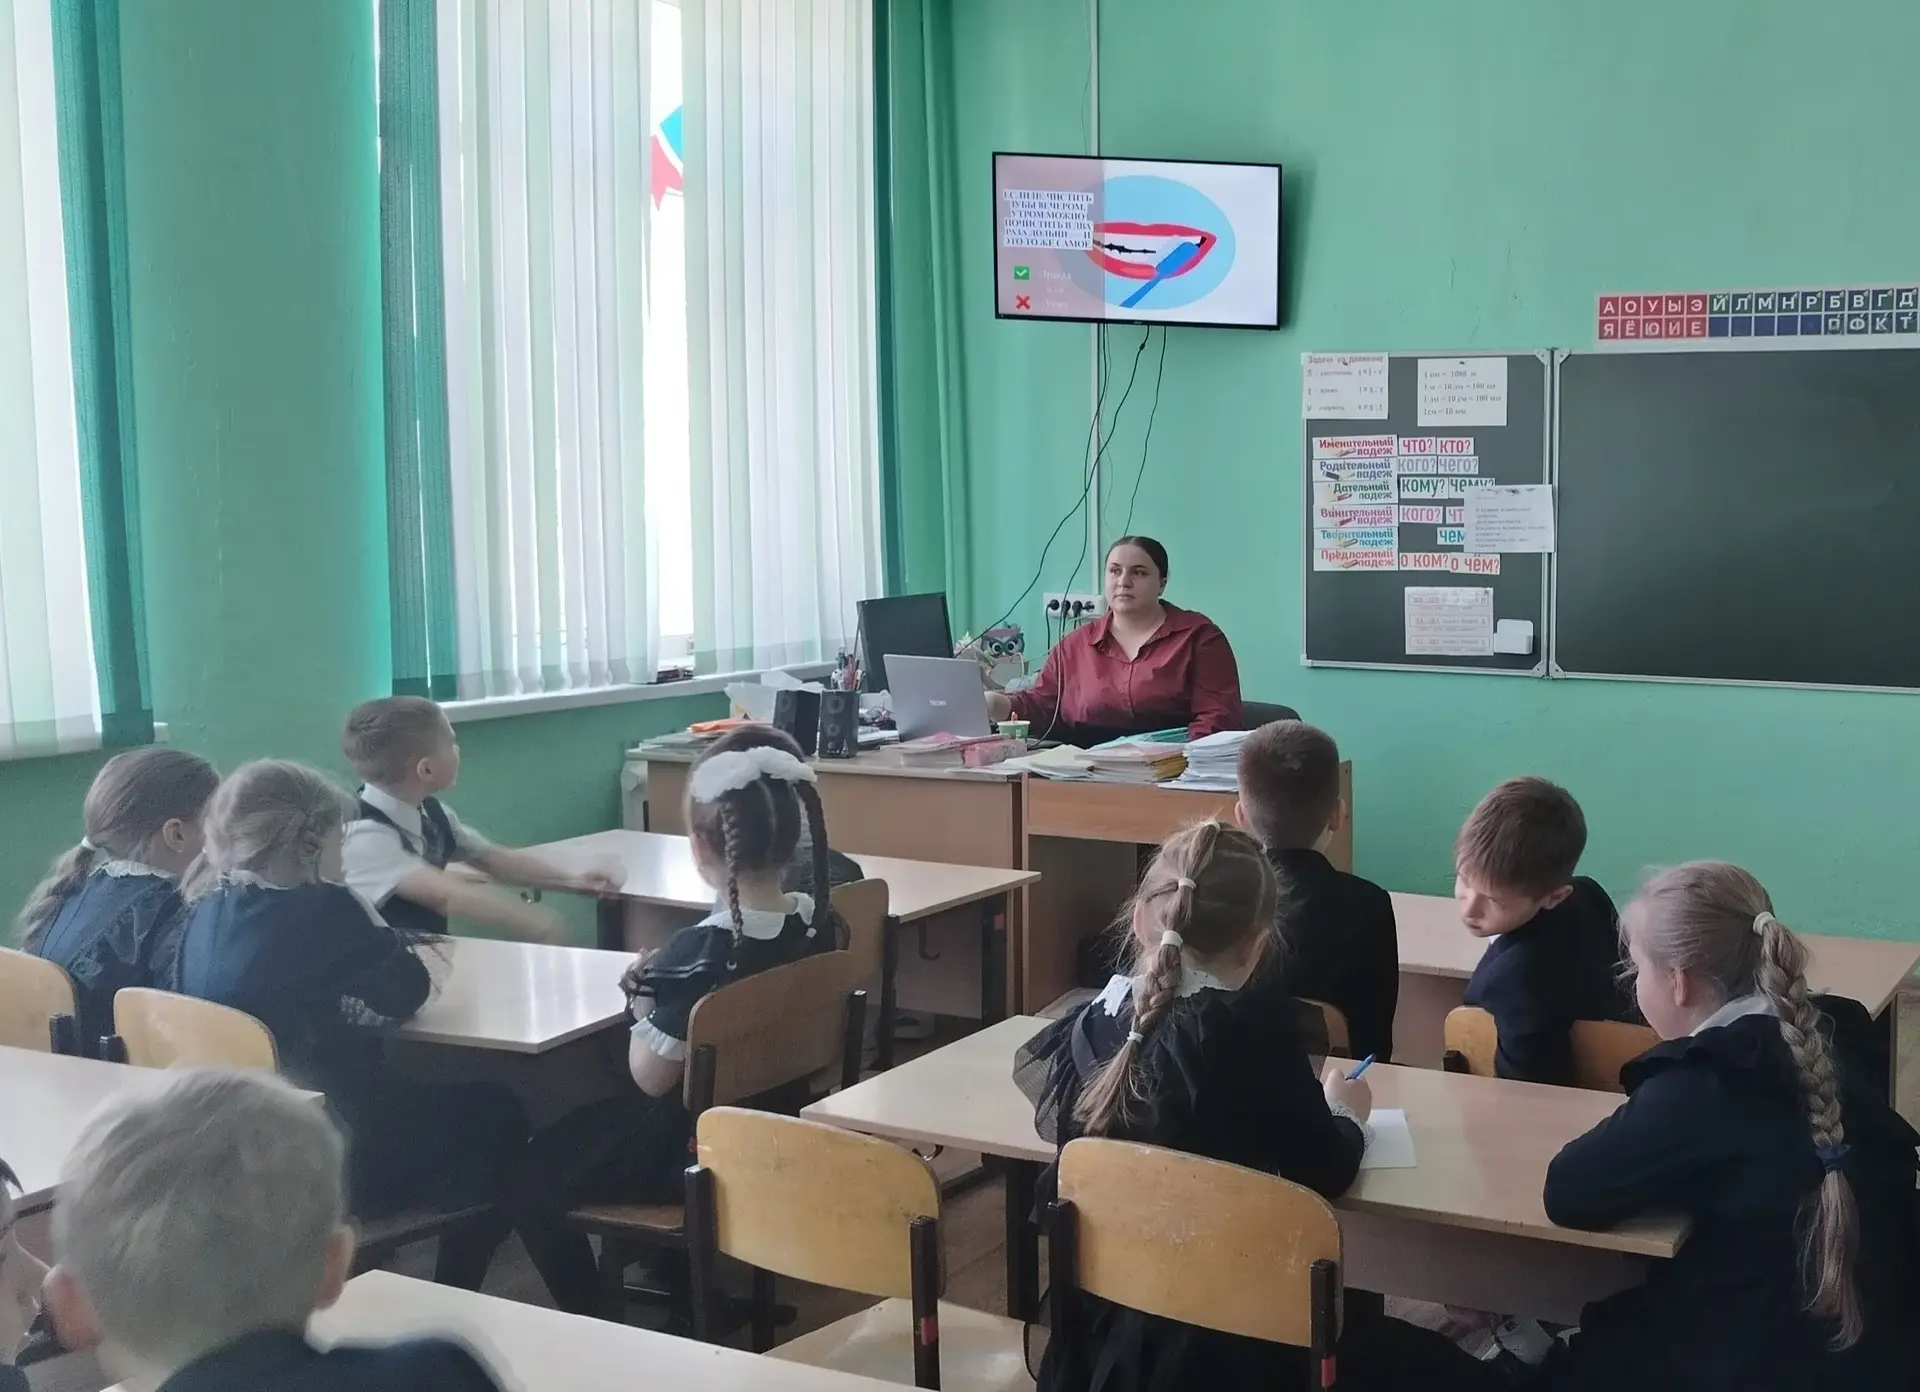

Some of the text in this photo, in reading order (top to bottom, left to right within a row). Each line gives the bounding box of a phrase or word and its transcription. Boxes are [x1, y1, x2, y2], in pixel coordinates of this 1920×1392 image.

[1047, 192, 1092, 202] ЧИСТИТЬ
[1011, 210, 1085, 220] УТРОМ МОЖНО
[1005, 219, 1063, 229] ПОЧИСТИТЬ
[1604, 292, 1913, 313] А О У Ы Э Й Л М Н Р Б В Г Д
[1604, 323, 1614, 336] Я
[1626, 320, 1635, 335] Ё
[1645, 322, 1659, 335] Ю
[1669, 321, 1680, 335] И
[1692, 321, 1701, 335] Е
[1850, 317, 1864, 330] Ф
[1876, 318, 1887, 330] К
[1900, 316, 1911, 329] Т
[1320, 437, 1394, 448] Именительный
[1357, 447, 1392, 457] падеж
[1320, 459, 1390, 471] Родительный
[1357, 470, 1392, 480] падеж
[1334, 481, 1389, 494] Дательный
[1359, 492, 1392, 501] падеж
[1320, 506, 1392, 518] Винительный
[1358, 517, 1392, 526] падеж
[1321, 528, 1393, 542] Творительный
[1440, 530, 1464, 543] чем
[1321, 548, 1393, 561] Предложный
[1358, 559, 1394, 568] падеж
